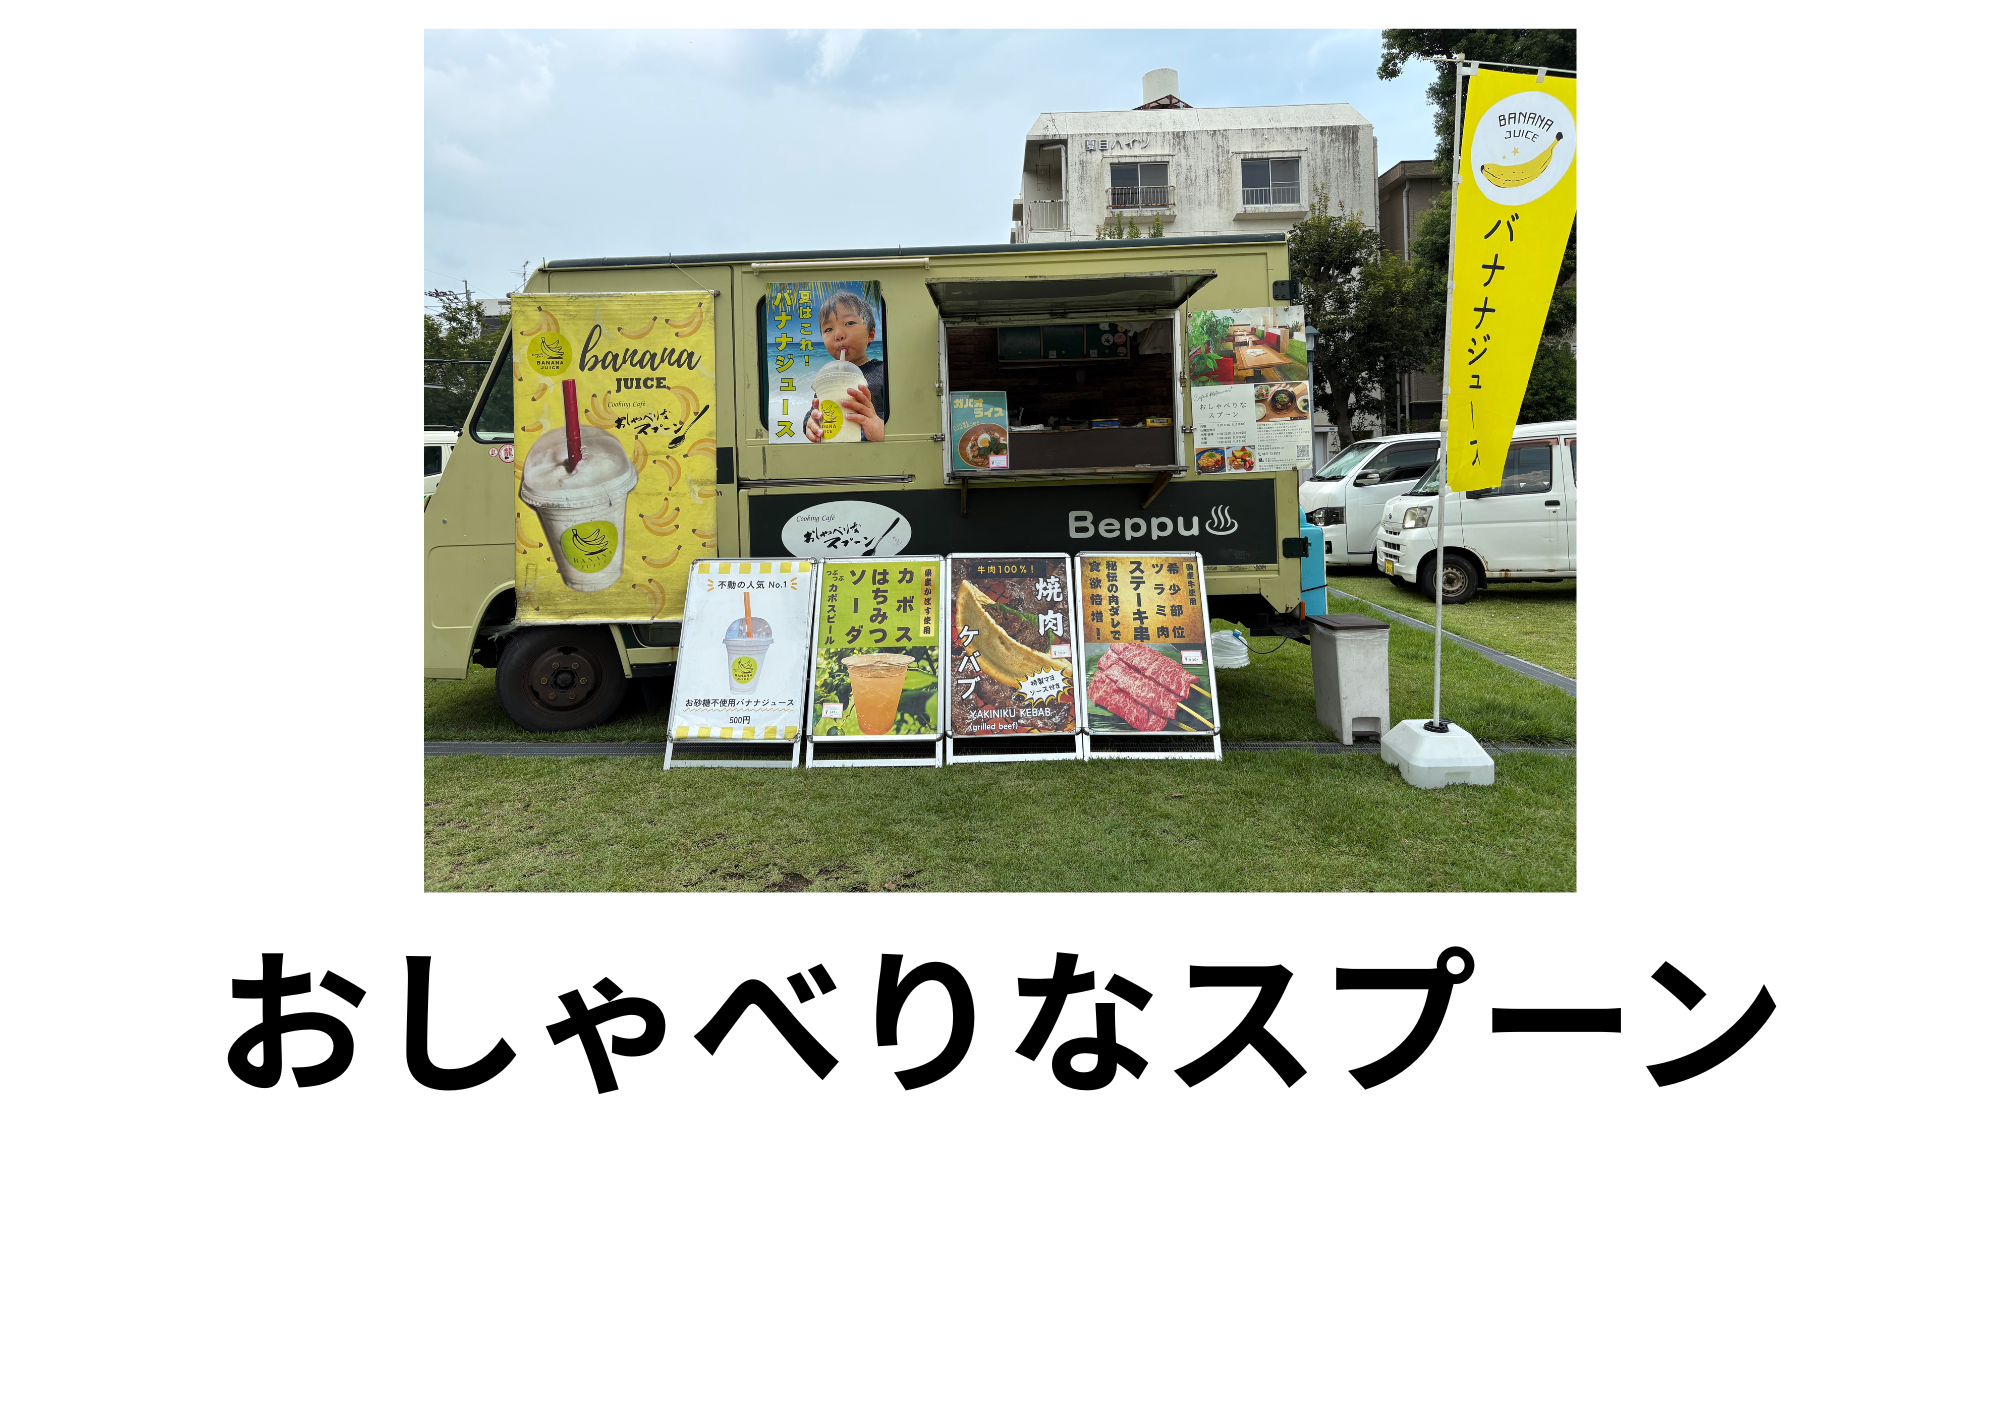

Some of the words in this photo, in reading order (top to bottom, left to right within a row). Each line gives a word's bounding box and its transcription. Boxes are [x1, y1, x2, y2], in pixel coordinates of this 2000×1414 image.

[1498, 111, 1554, 133] BANANA
[1505, 129, 1539, 143] JUICE
[798, 290, 813, 367] 夏はこれ！
[1468, 213, 1520, 466] バナナジュース
[579, 324, 702, 372] banana
[773, 290, 796, 438] バナナジュース
[615, 377, 667, 393] JUICE
[607, 401, 631, 409] Cooking
[953, 398, 984, 409] ガパオ
[973, 407, 1005, 418] ライス
[1200, 402, 1247, 410] おしゃべりな
[614, 408, 672, 430] おしゃべりな
[796, 515, 820, 523] Cooking
[1068, 510, 1199, 541] Beppu
[803, 521, 862, 544] おしゃべりな
[717, 580, 765, 590] 不動の人気
[768, 581, 787, 589] No.1
[845, 569, 866, 645] ソーダ
[869, 568, 890, 644] はちみつ
[894, 567, 915, 643] カボス
[1035, 575, 1064, 637] 焼肉
[1088, 560, 1104, 641] 食欲倍増！
[1105, 560, 1122, 641] 秘伝の肉ダレで
[1129, 560, 1151, 643] ステーキ串
[1151, 563, 1170, 639] ツラミ肉
[1166, 563, 1186, 639] 希少部位
[824, 583, 838, 645] カボスビール
[957, 625, 981, 700] ケバブ
[1029, 682, 1061, 696] ソース付き
[1030, 674, 1055, 687] 特製マヨ
[685, 698, 795, 707] お砂糖不使用バナナジュース
[969, 709, 1016, 719] YAKINIKU
[1020, 707, 1051, 717] KEBAB
[729, 715, 751, 724] 500円
[969, 722, 996, 732] (grilled
